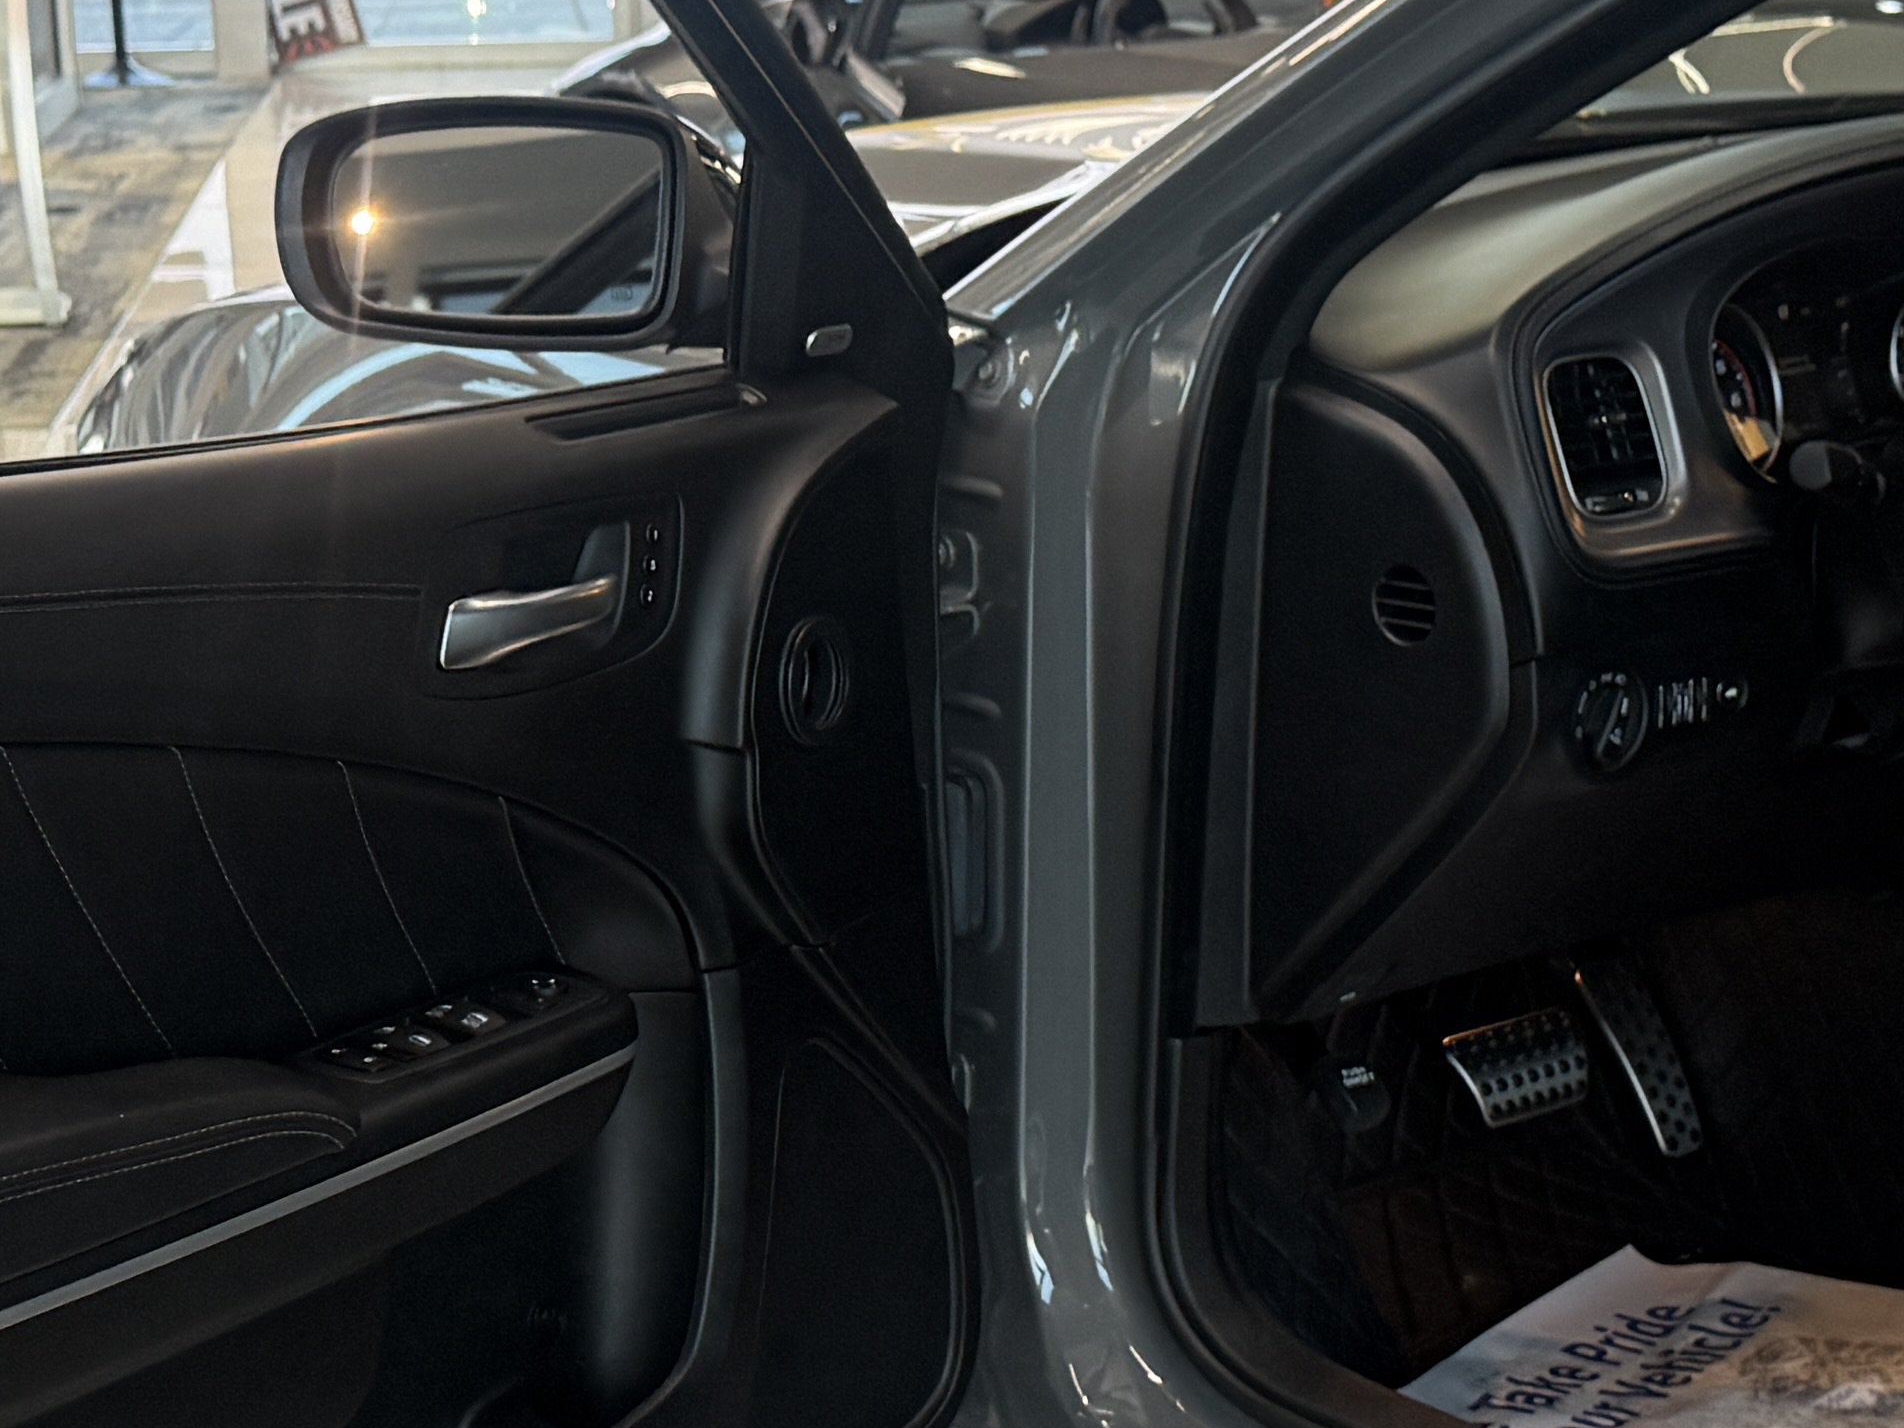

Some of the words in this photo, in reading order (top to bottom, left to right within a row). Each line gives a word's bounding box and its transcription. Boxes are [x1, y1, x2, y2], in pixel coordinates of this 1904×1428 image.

[1467, 1365, 1600, 1415] Take
[1560, 1304, 1696, 1366] Pride
[1599, 1297, 1782, 1399] Vehicle!
